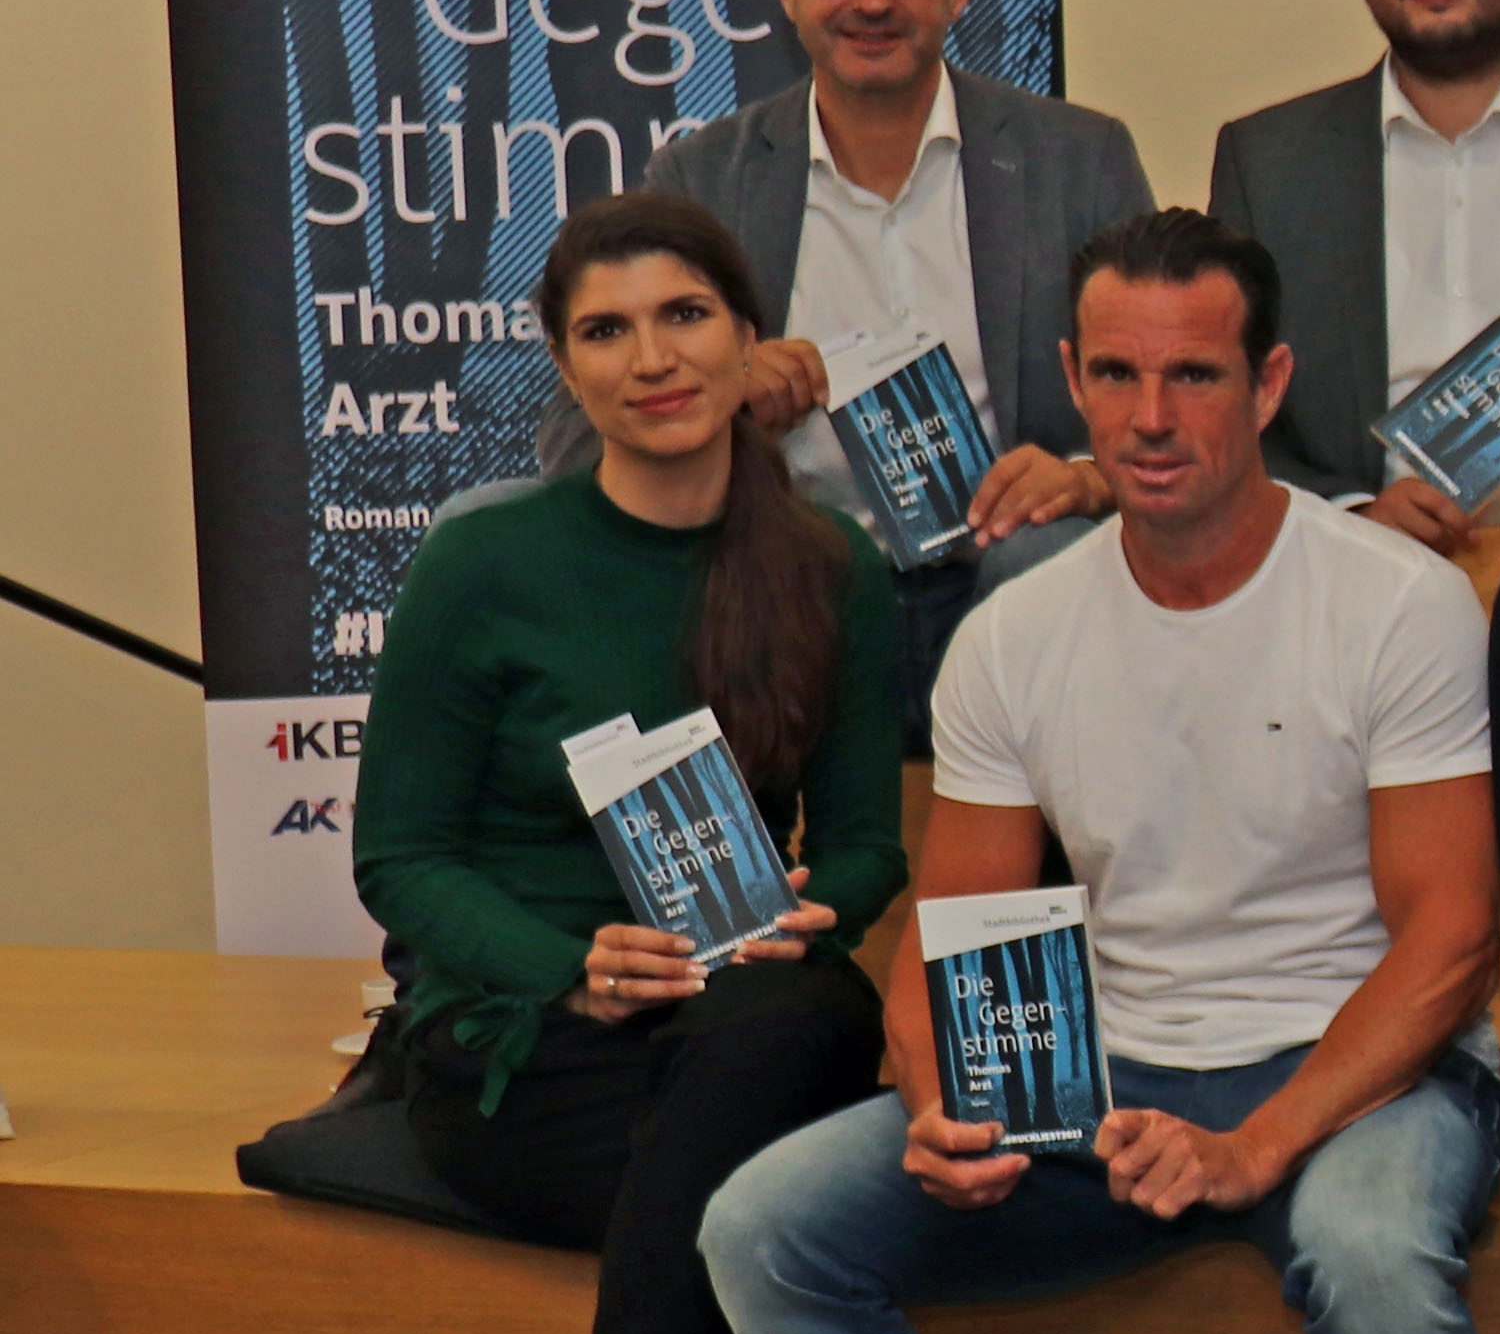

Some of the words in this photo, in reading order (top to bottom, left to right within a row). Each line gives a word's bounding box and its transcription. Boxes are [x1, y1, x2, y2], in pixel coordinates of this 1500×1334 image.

[303, 86, 706, 227] stim
[315, 288, 543, 347] Thoma
[322, 383, 459, 438] Arzt
[860, 407, 895, 434] Die
[324, 505, 432, 532] Roman
[622, 808, 662, 840] Die
[648, 838, 735, 890] stimme
[954, 973, 994, 1000] Die
[979, 1000, 1067, 1031] Gegen-
[963, 1030, 1059, 1059] stimme
